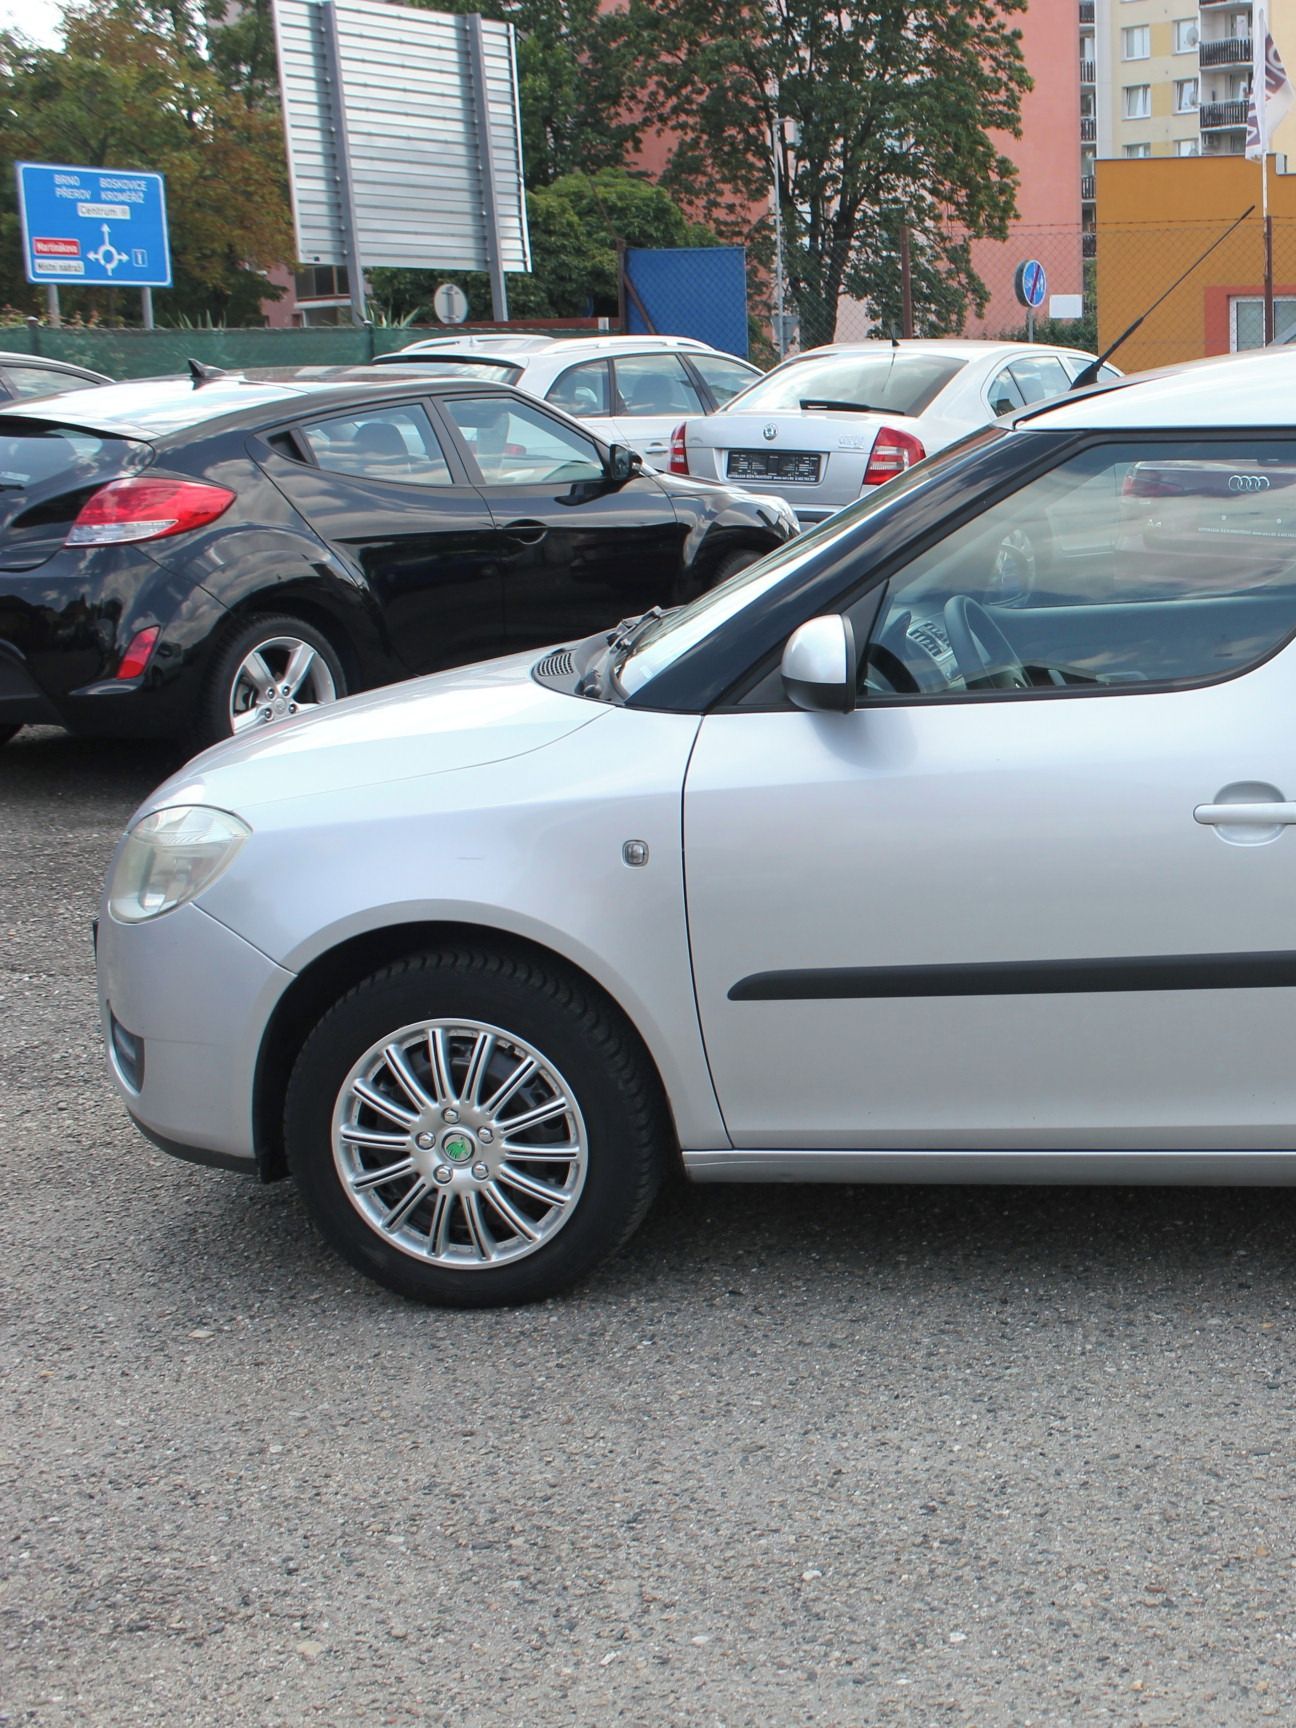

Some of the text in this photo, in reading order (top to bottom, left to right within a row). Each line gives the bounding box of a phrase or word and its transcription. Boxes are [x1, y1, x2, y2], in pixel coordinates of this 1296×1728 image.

[54, 174, 80, 186] BRNO
[99, 177, 147, 191] BOSKOVICE
[55, 186, 91, 199] PŘEROV
[80, 206, 117, 217] Centrum
